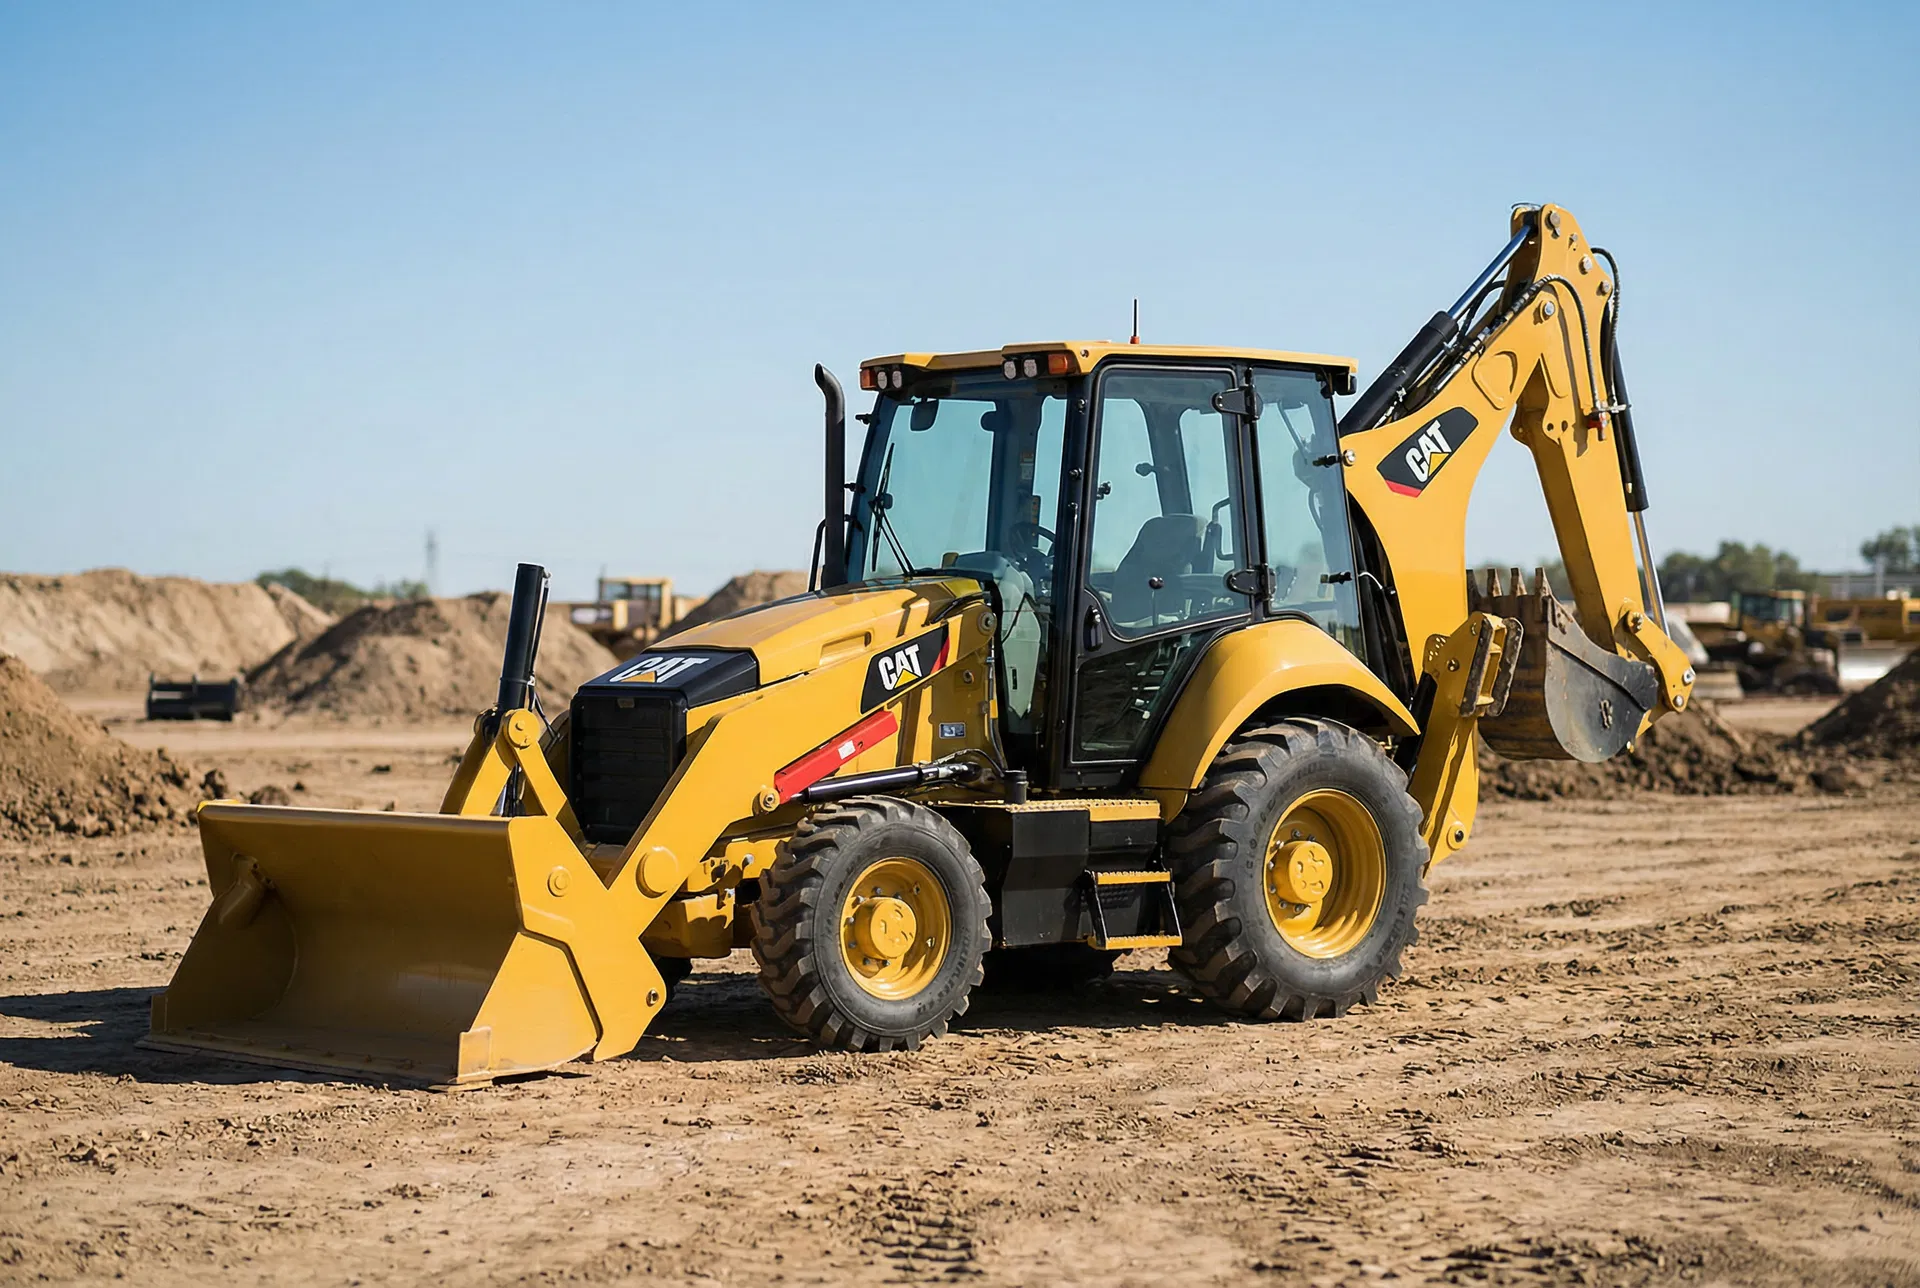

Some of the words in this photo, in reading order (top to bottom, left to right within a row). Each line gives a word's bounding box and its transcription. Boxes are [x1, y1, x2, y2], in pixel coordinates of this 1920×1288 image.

[1405, 420, 1452, 482] CAT
[609, 657, 710, 683] CAT
[878, 643, 922, 691] CAT
